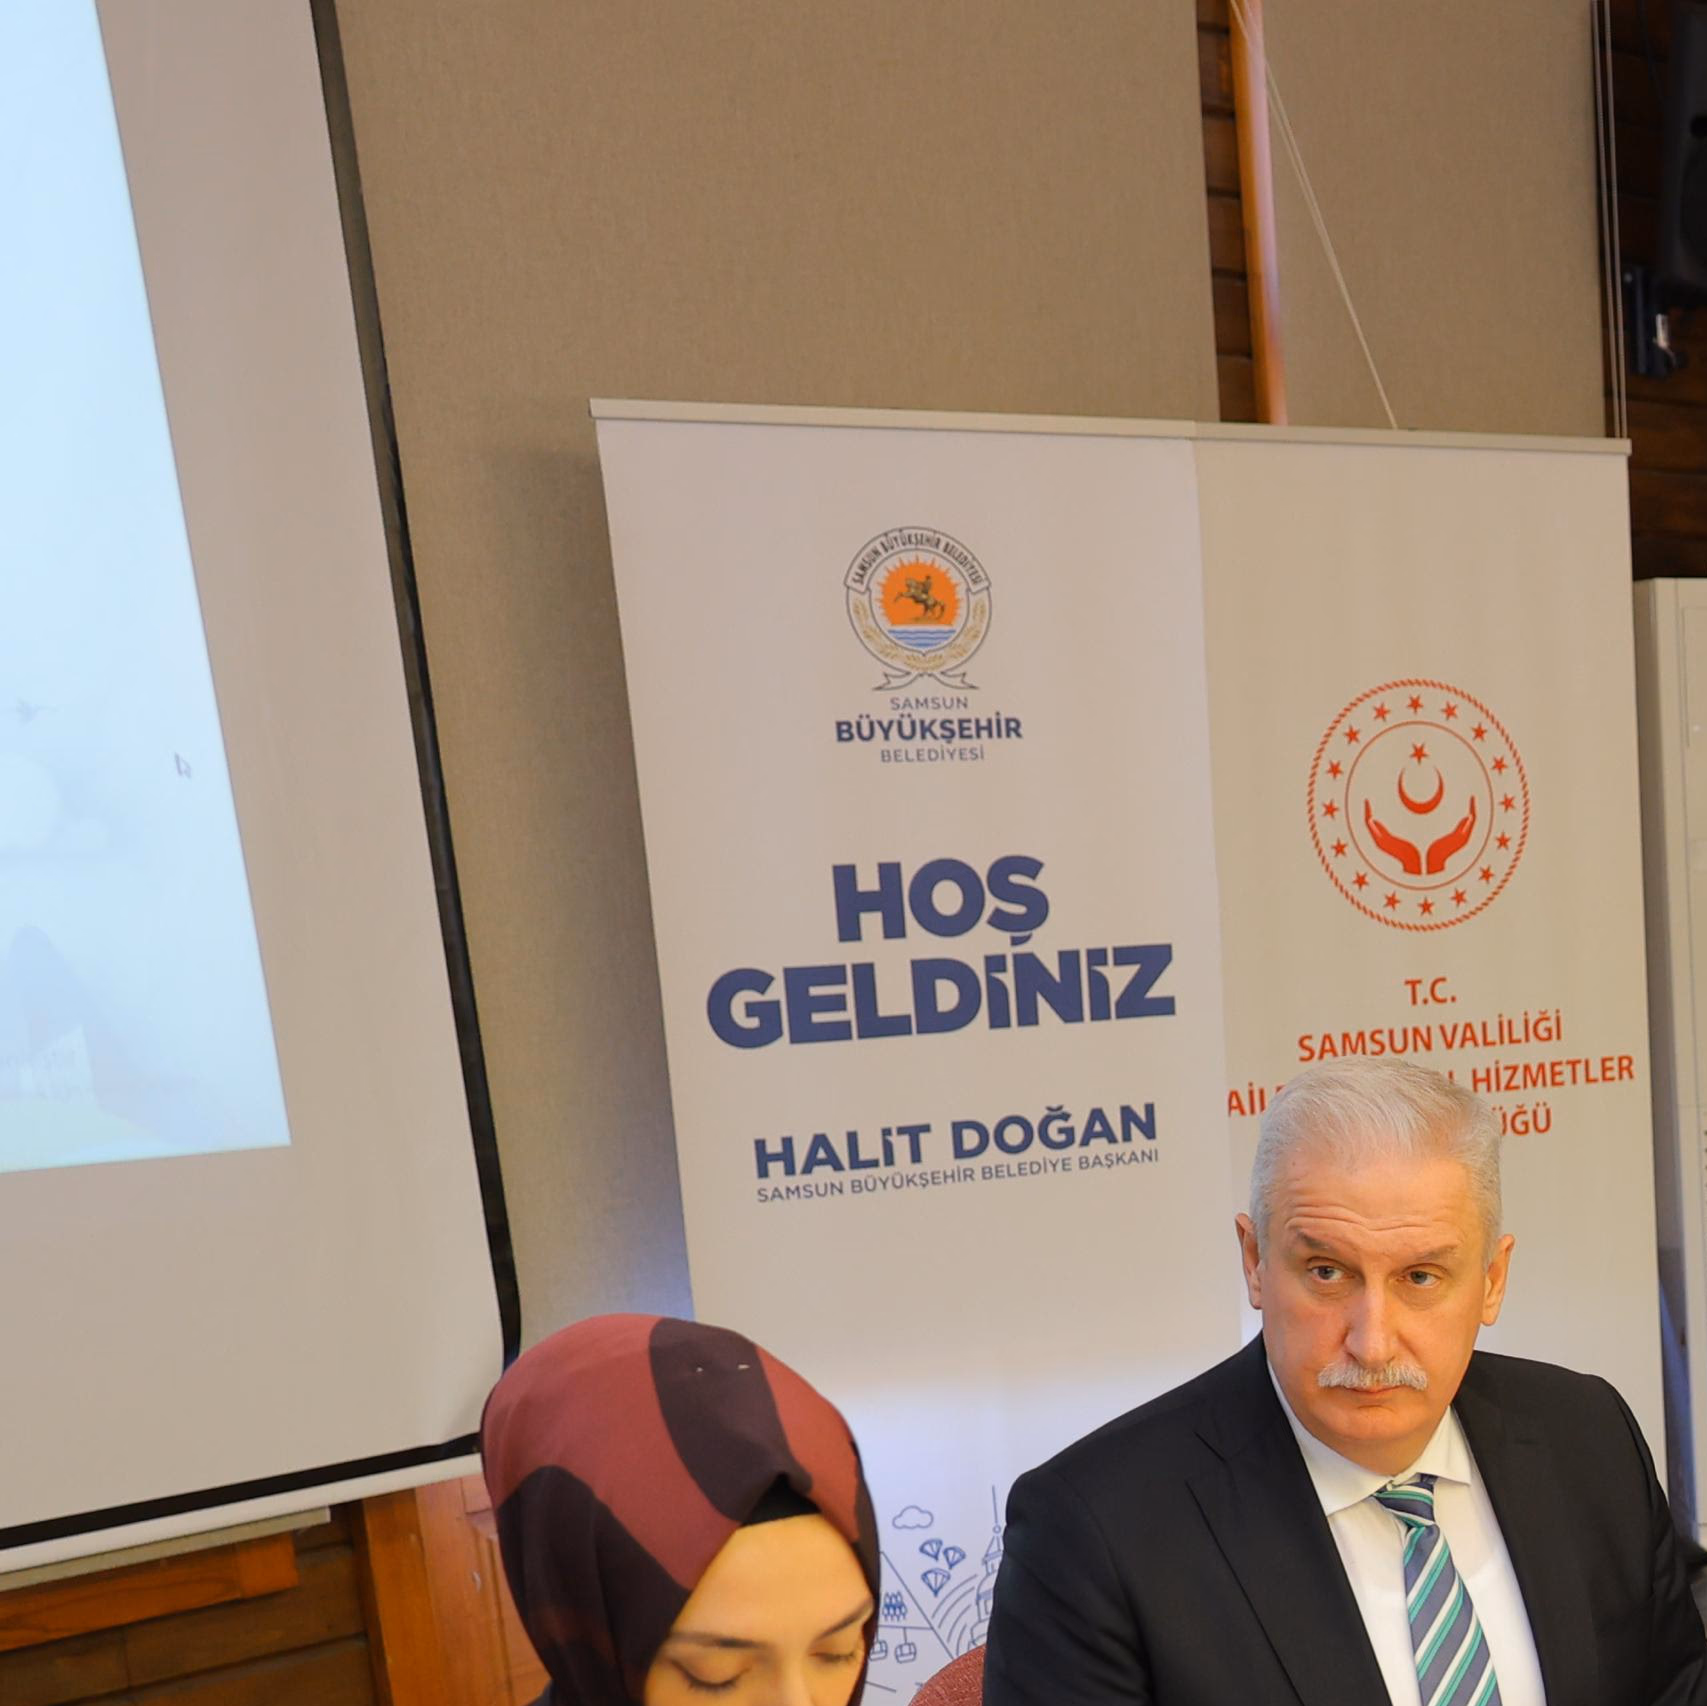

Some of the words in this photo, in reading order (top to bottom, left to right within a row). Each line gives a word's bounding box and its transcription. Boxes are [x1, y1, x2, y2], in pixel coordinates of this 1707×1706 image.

[835, 711, 1023, 744] BÜYÜKŞEHİR
[890, 697, 969, 711] SAMSUN
[880, 745, 985, 764] BELEDİYESİ
[831, 855, 1050, 947] HOŞ
[706, 943, 1177, 1050] GELDİNİZ
[1404, 976, 1457, 1007] T.C.
[1297, 1023, 1433, 1063] SAMSUN
[1439, 1008, 1563, 1050] VALİLİĞİ
[1227, 1081, 1287, 1118] AİL
[1471, 1055, 1635, 1094] HİZMETLER
[753, 1122, 932, 1180] HALİT
[950, 1101, 1157, 1161] DOĞAN
[756, 1180, 845, 1204] SAMSUN
[850, 1163, 976, 1196] BÜYÜKŞEHİR
[980, 1154, 1073, 1181] BELEDİYE
[1078, 1147, 1160, 1172] BAŞKANI
